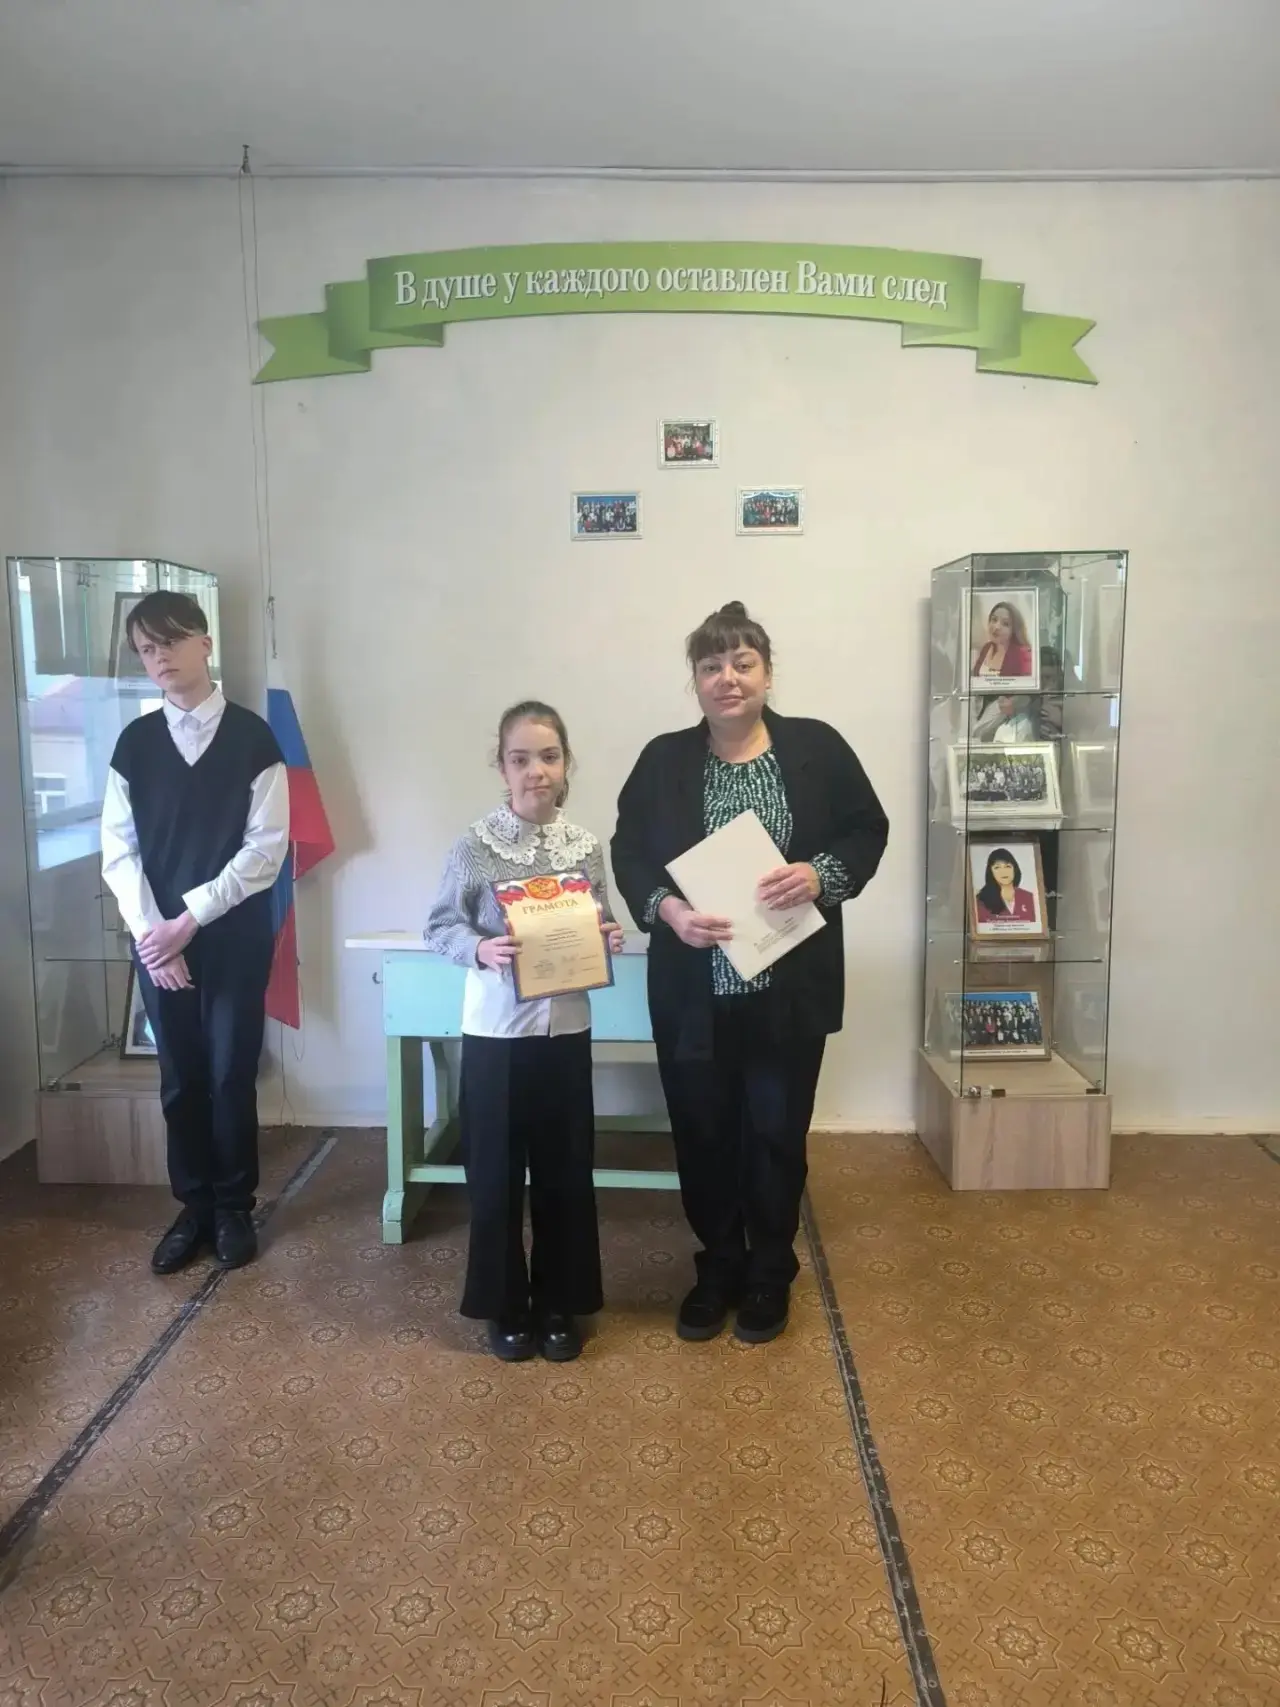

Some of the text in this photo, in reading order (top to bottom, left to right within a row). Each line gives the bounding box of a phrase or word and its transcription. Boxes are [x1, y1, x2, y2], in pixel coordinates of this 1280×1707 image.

[394, 260, 947, 310] В душе у каждого оставлен Вами след
[522, 898, 579, 914] ГРАМОТА
